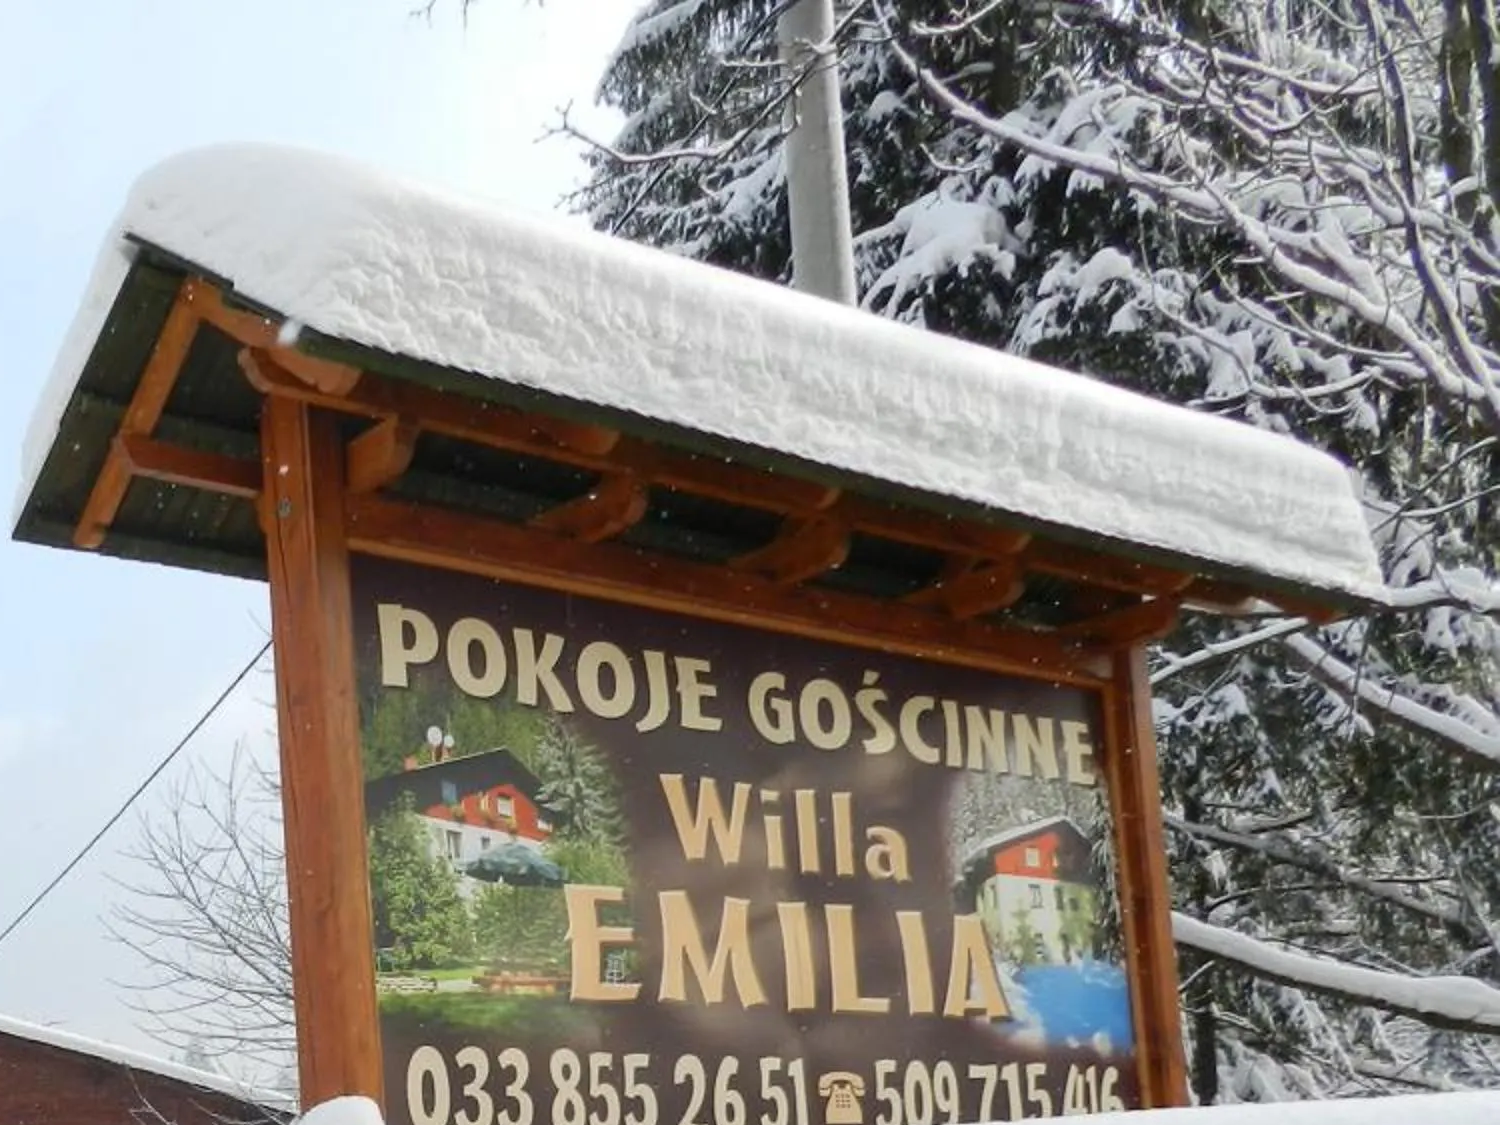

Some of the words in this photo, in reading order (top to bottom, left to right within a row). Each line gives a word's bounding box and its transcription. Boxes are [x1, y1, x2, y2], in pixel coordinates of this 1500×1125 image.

[376, 603, 722, 733] POKOJE
[748, 670, 1099, 786] GOŚCINNE
[660, 773, 911, 882] Willa
[564, 883, 1010, 1022] EMILIA
[969, 1063, 1050, 1120] 715
